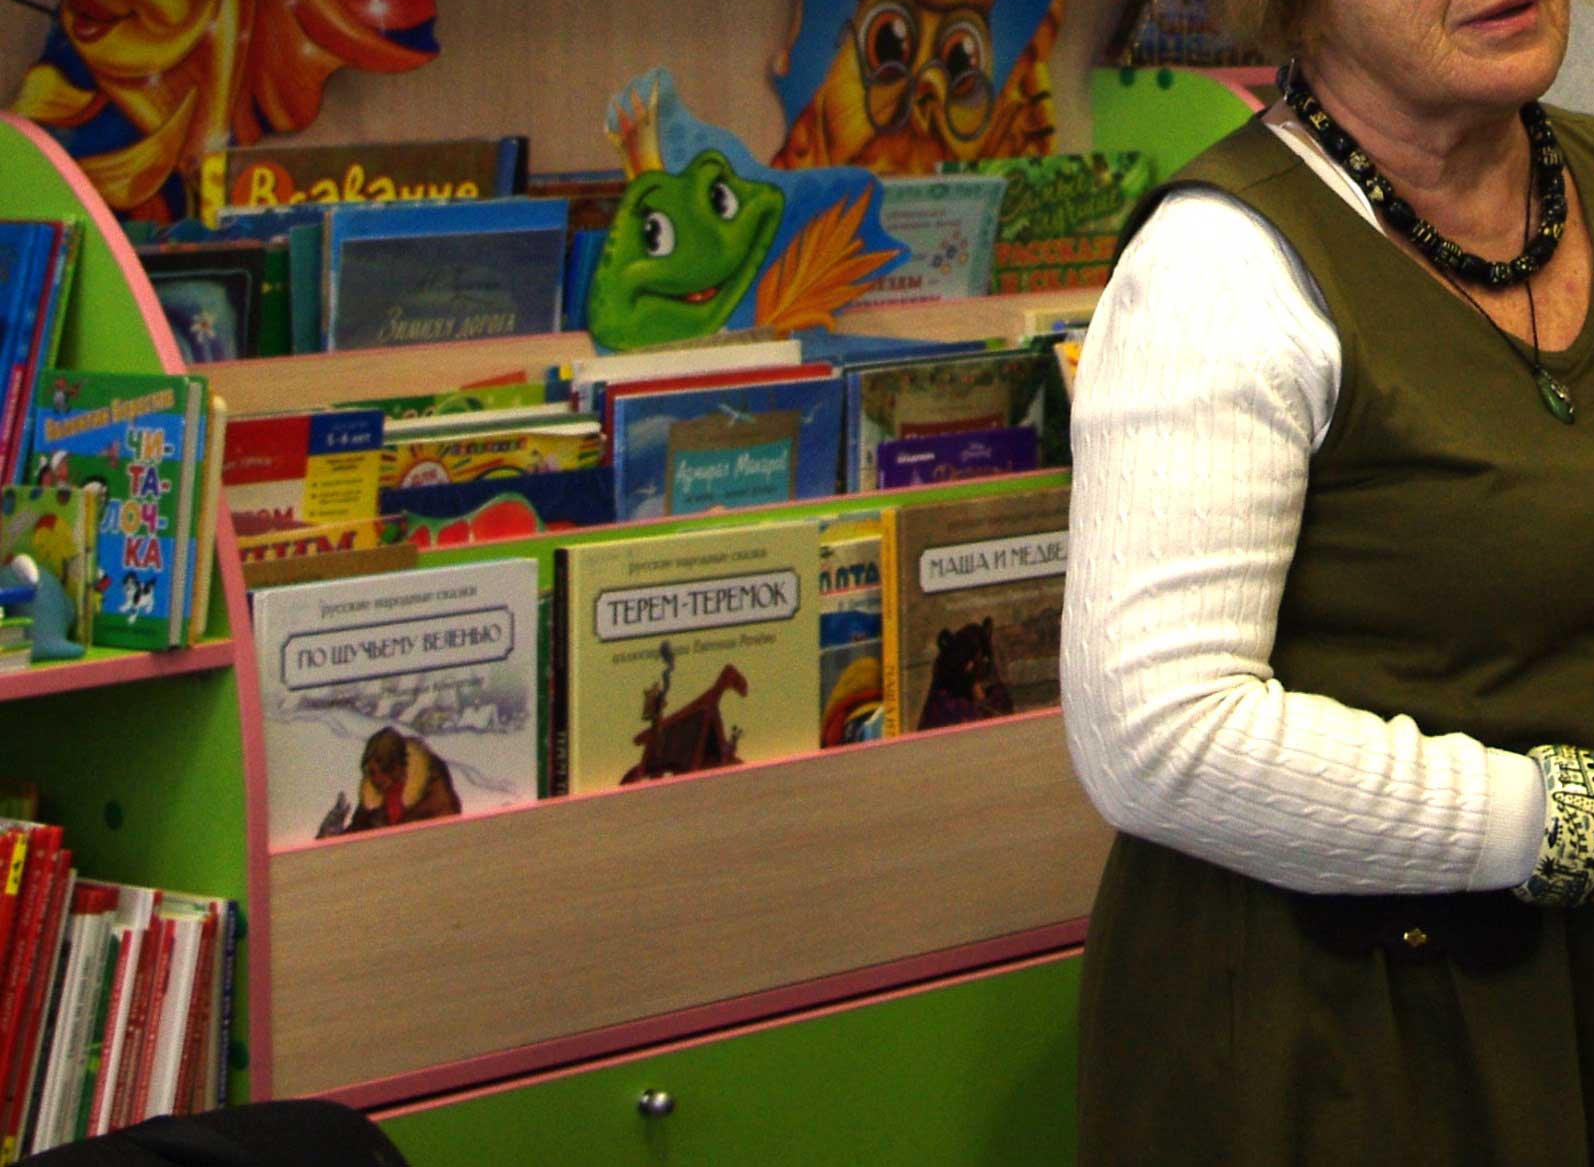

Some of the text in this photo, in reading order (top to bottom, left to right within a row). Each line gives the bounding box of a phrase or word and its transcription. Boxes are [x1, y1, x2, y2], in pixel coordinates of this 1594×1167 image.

[127, 428, 176, 464] ЧИ-
[128, 464, 171, 497] ТА-
[123, 537, 163, 570] КА
[929, 541, 1068, 577] МАША И МЕДВЕ
[607, 582, 788, 626] ТЕРЕМ-ТЕРЕМОК
[298, 646, 327, 670] ПО
[423, 623, 502, 653] ВЕЛЕНЬЮ
